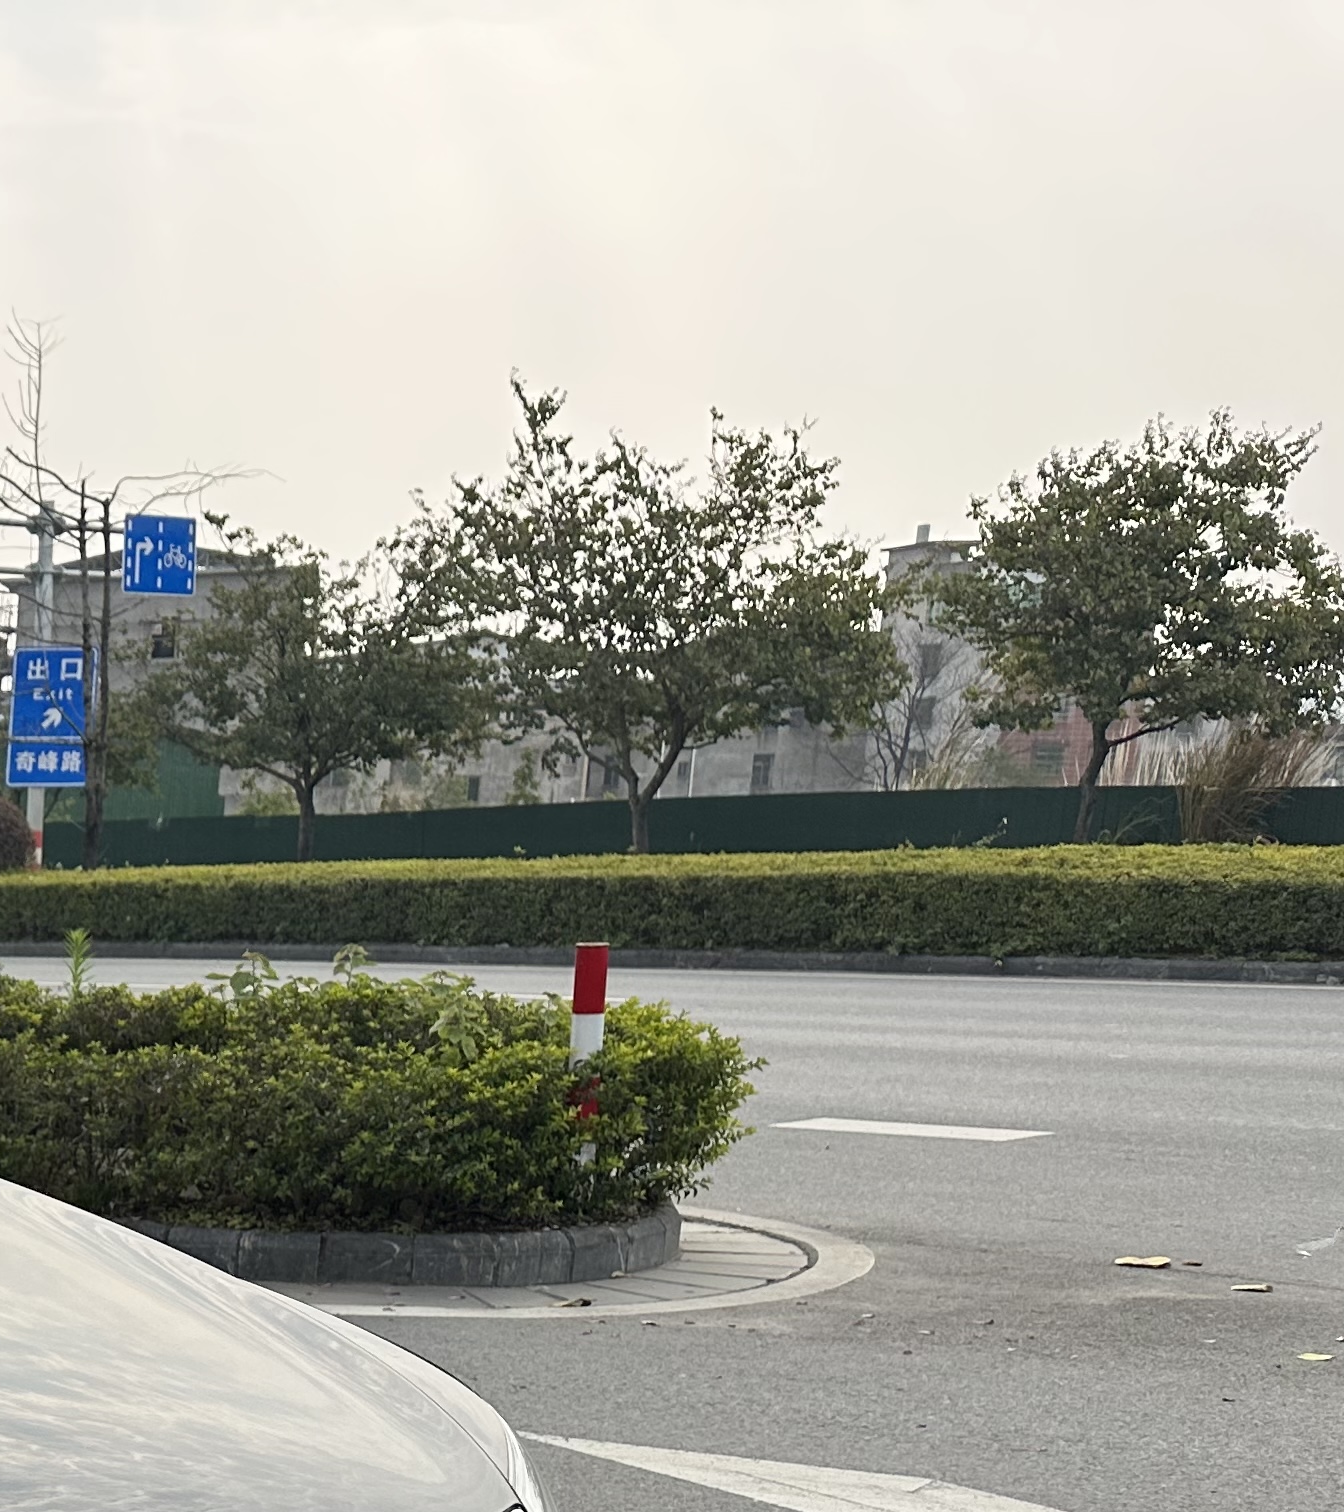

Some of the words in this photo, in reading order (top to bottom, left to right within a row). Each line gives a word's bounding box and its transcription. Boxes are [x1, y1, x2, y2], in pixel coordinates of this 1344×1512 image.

[27, 658, 83, 680] 出口
[16, 750, 81, 773] 奇峰路
